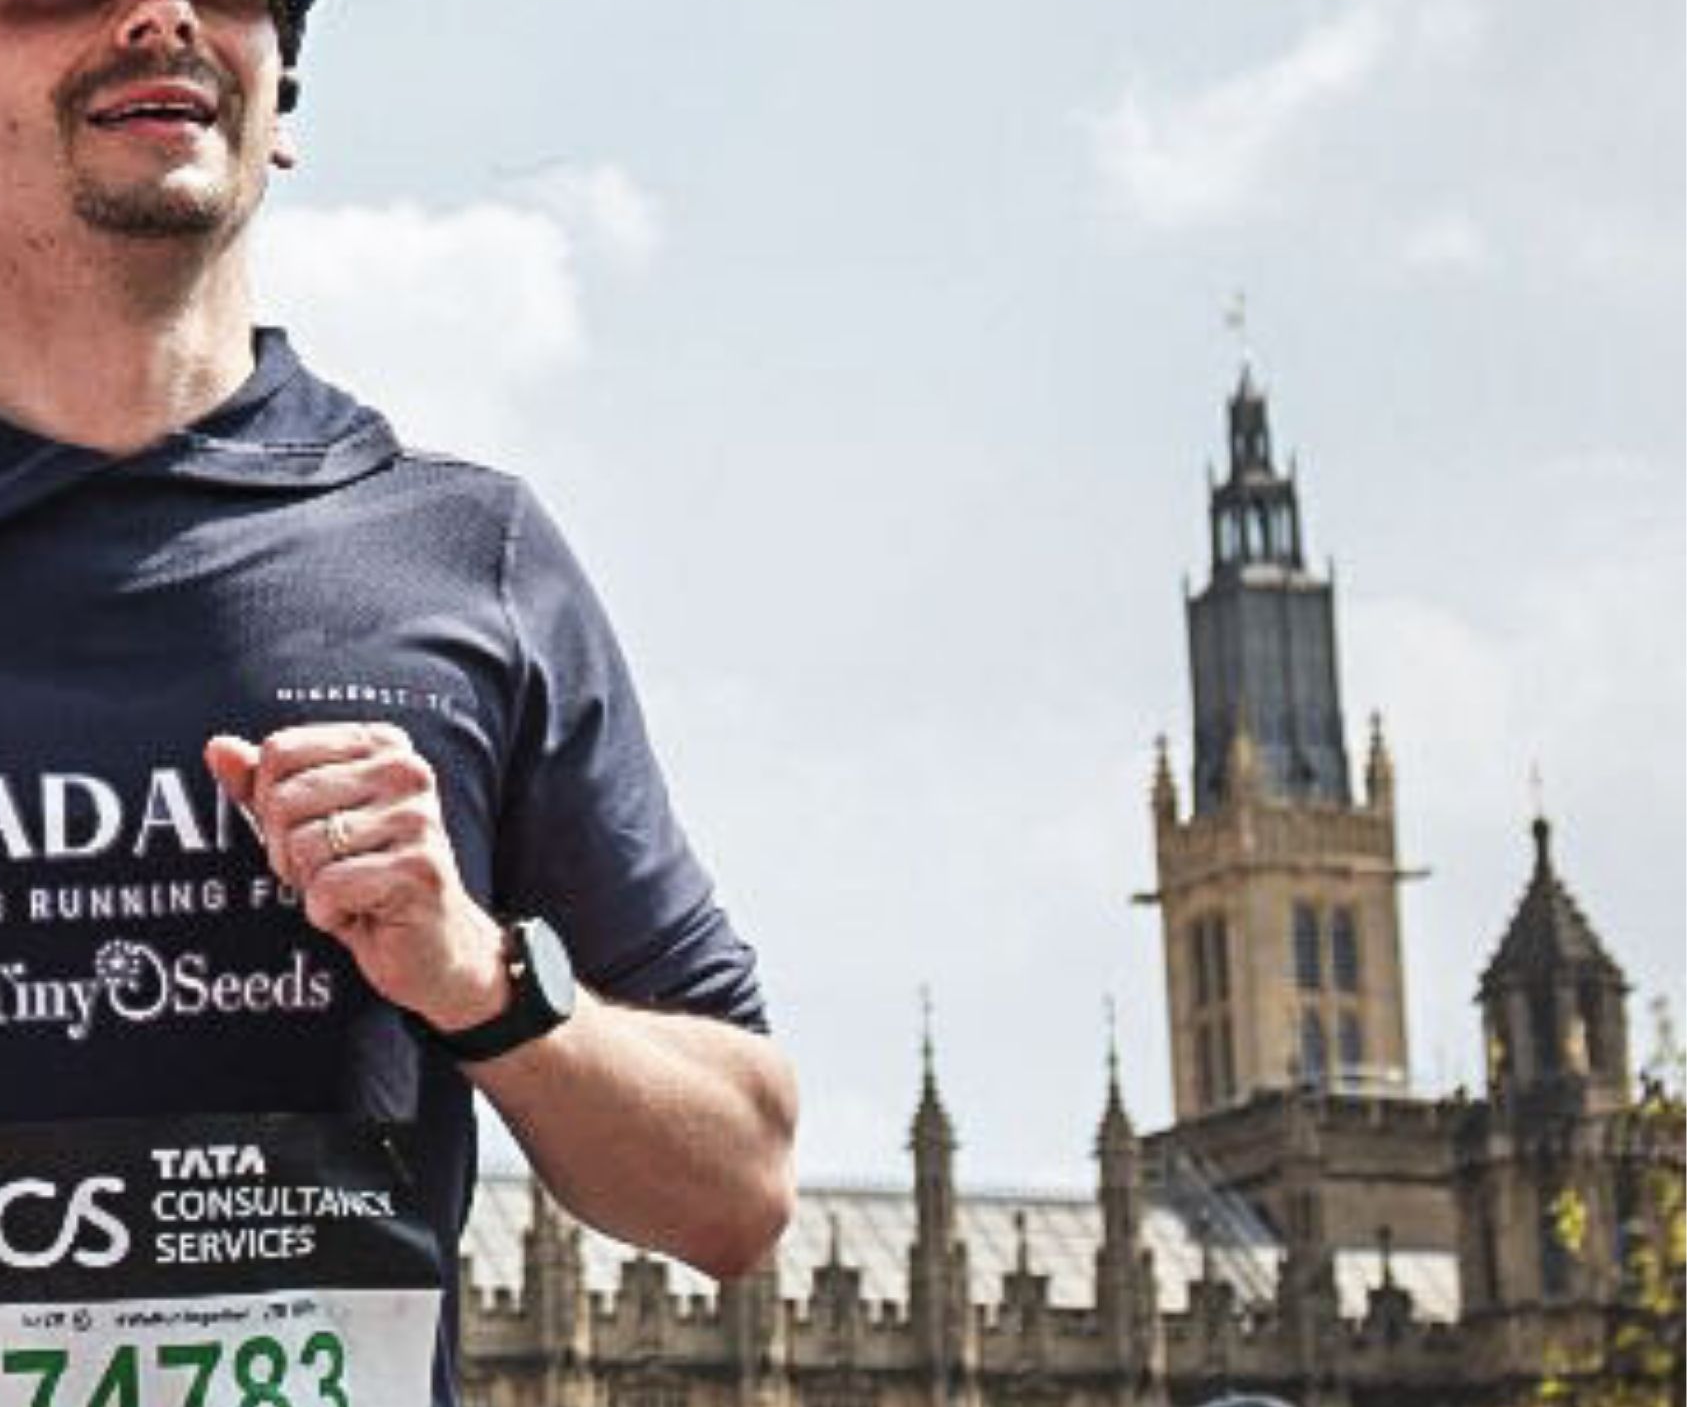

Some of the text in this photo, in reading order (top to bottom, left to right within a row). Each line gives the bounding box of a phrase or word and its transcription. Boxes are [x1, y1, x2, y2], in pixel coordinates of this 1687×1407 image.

[29, 878, 226, 920] RUNNING
[250, 877, 300, 908] FO
[173, 948, 332, 1015] Seeds
[151, 1144, 266, 1180] TATA
[155, 1224, 317, 1265] SERVICES
